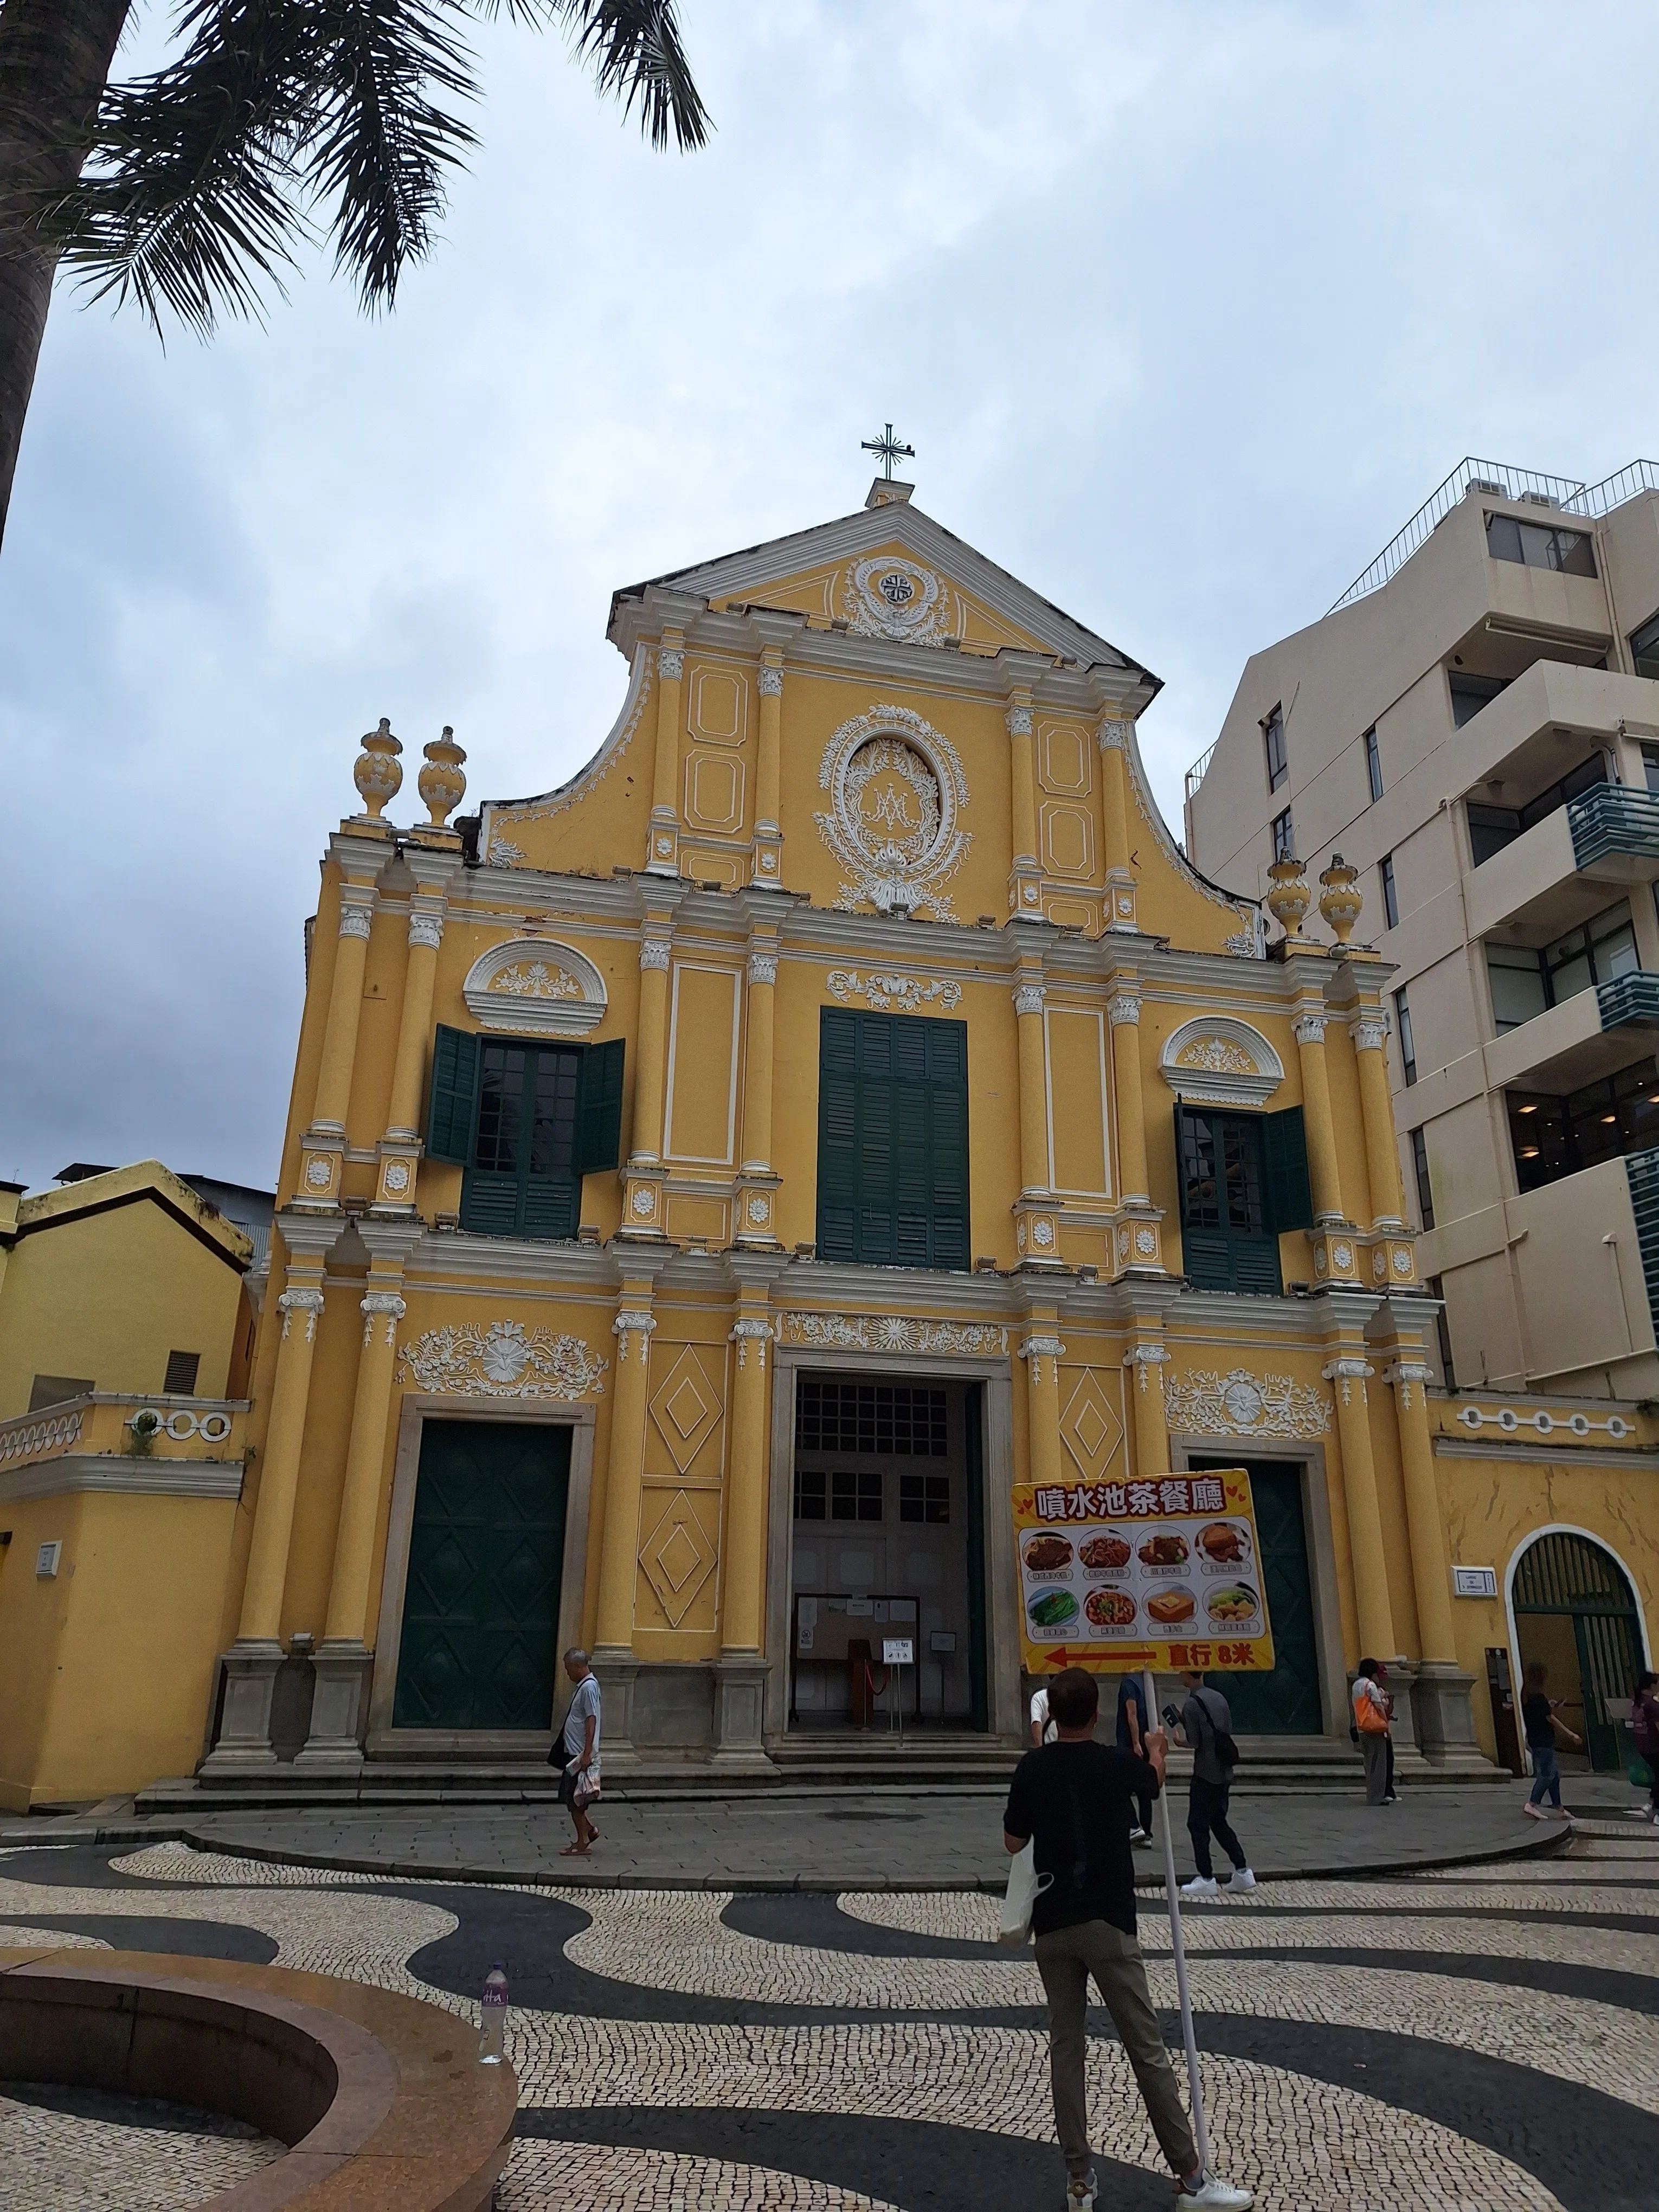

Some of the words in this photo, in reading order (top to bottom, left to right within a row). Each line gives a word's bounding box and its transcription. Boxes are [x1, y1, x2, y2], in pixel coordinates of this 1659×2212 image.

[1037, 1477, 1224, 1520] 噴水池茶餐廳
[1168, 1643, 1212, 1667] 直行
[1218, 1642, 1255, 1666] 8米
